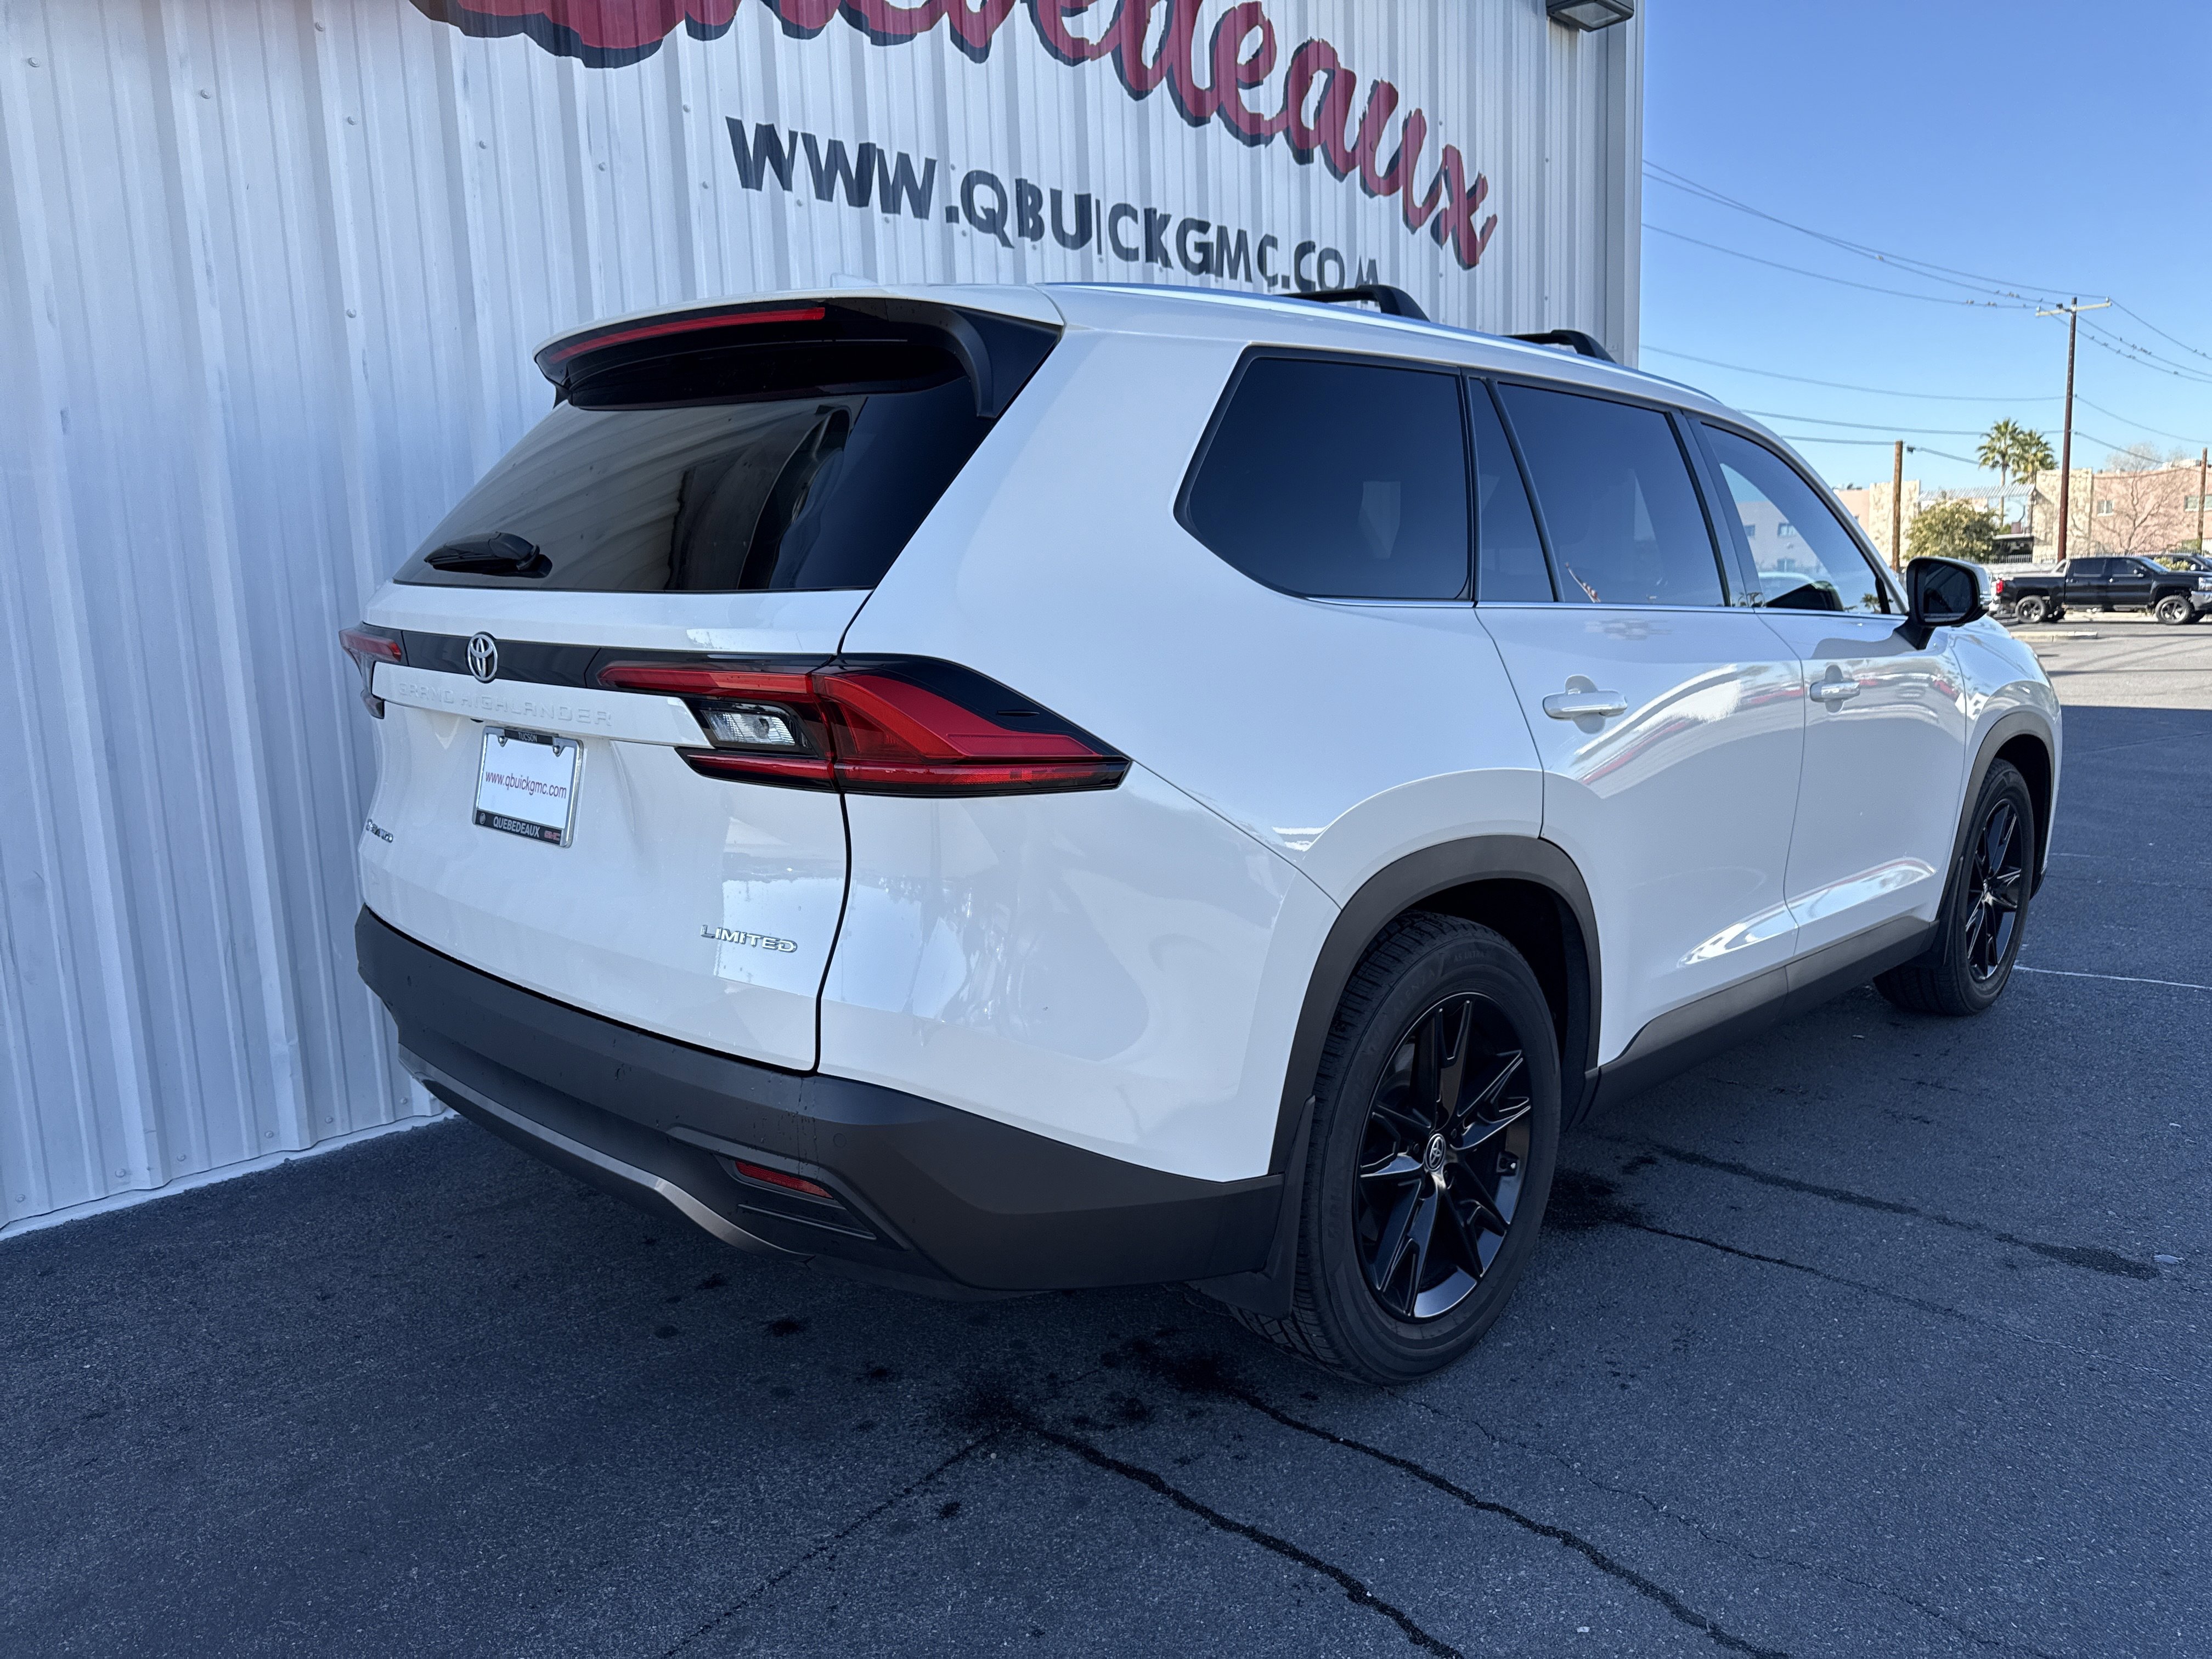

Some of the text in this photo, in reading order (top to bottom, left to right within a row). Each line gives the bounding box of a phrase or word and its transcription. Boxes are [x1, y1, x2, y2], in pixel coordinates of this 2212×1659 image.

[725, 116, 1380, 306] WWW.QBUICKGMC.COM
[398, 682, 613, 726] GRAND HIGHLANDER
[518, 732, 538, 742] TUCSON
[485, 770, 567, 799] www.qbuickgmc.com
[493, 815, 541, 838] QUEBEDEAUX
[700, 924, 798, 953] LIMITED
